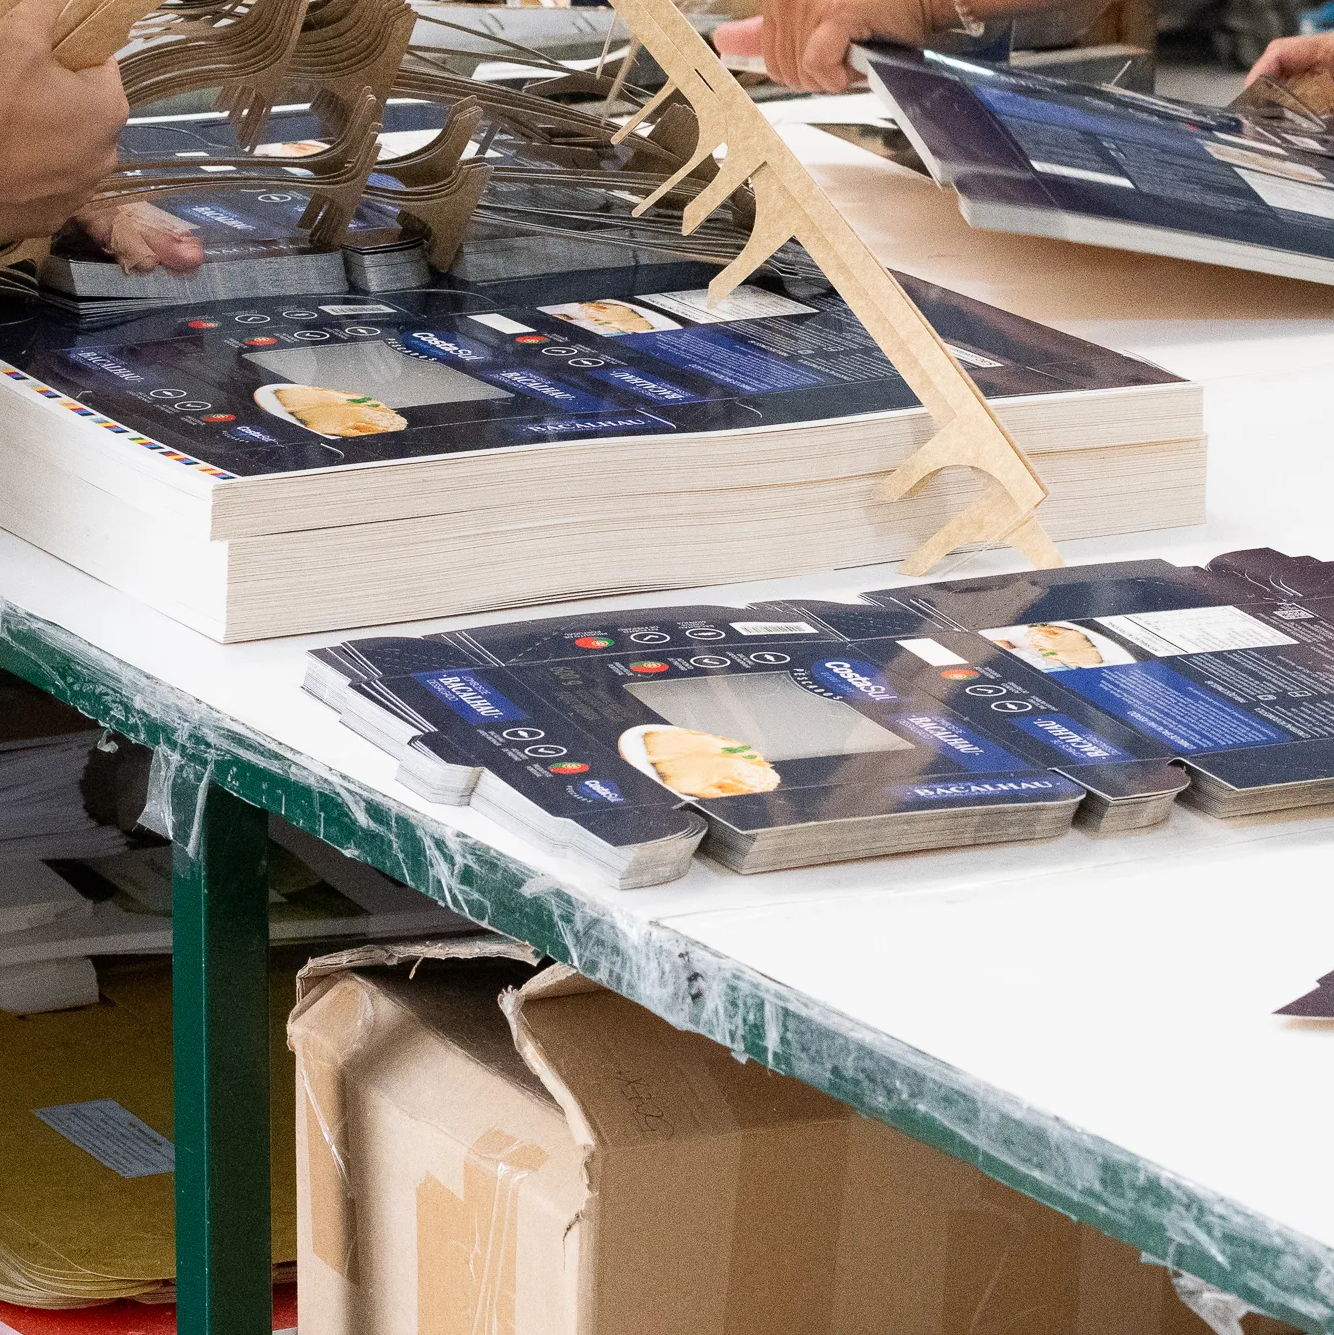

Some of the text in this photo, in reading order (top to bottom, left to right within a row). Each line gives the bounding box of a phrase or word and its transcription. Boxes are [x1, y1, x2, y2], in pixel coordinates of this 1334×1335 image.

[413, 332, 484, 361] CostaSul
[79, 351, 143, 382] BACALHAU
[500, 371, 574, 399] BACALHAU
[612, 372, 684, 400] BACALHAU
[528, 420, 645, 432] BACALHAU
[825, 662, 897, 700] CostaSul
[439, 676, 504, 718] BACALHAU
[908, 716, 984, 755] BACALHAU
[1033, 720, 1109, 758] BACALHAU
[915, 781, 1052, 796] BACALHAU
